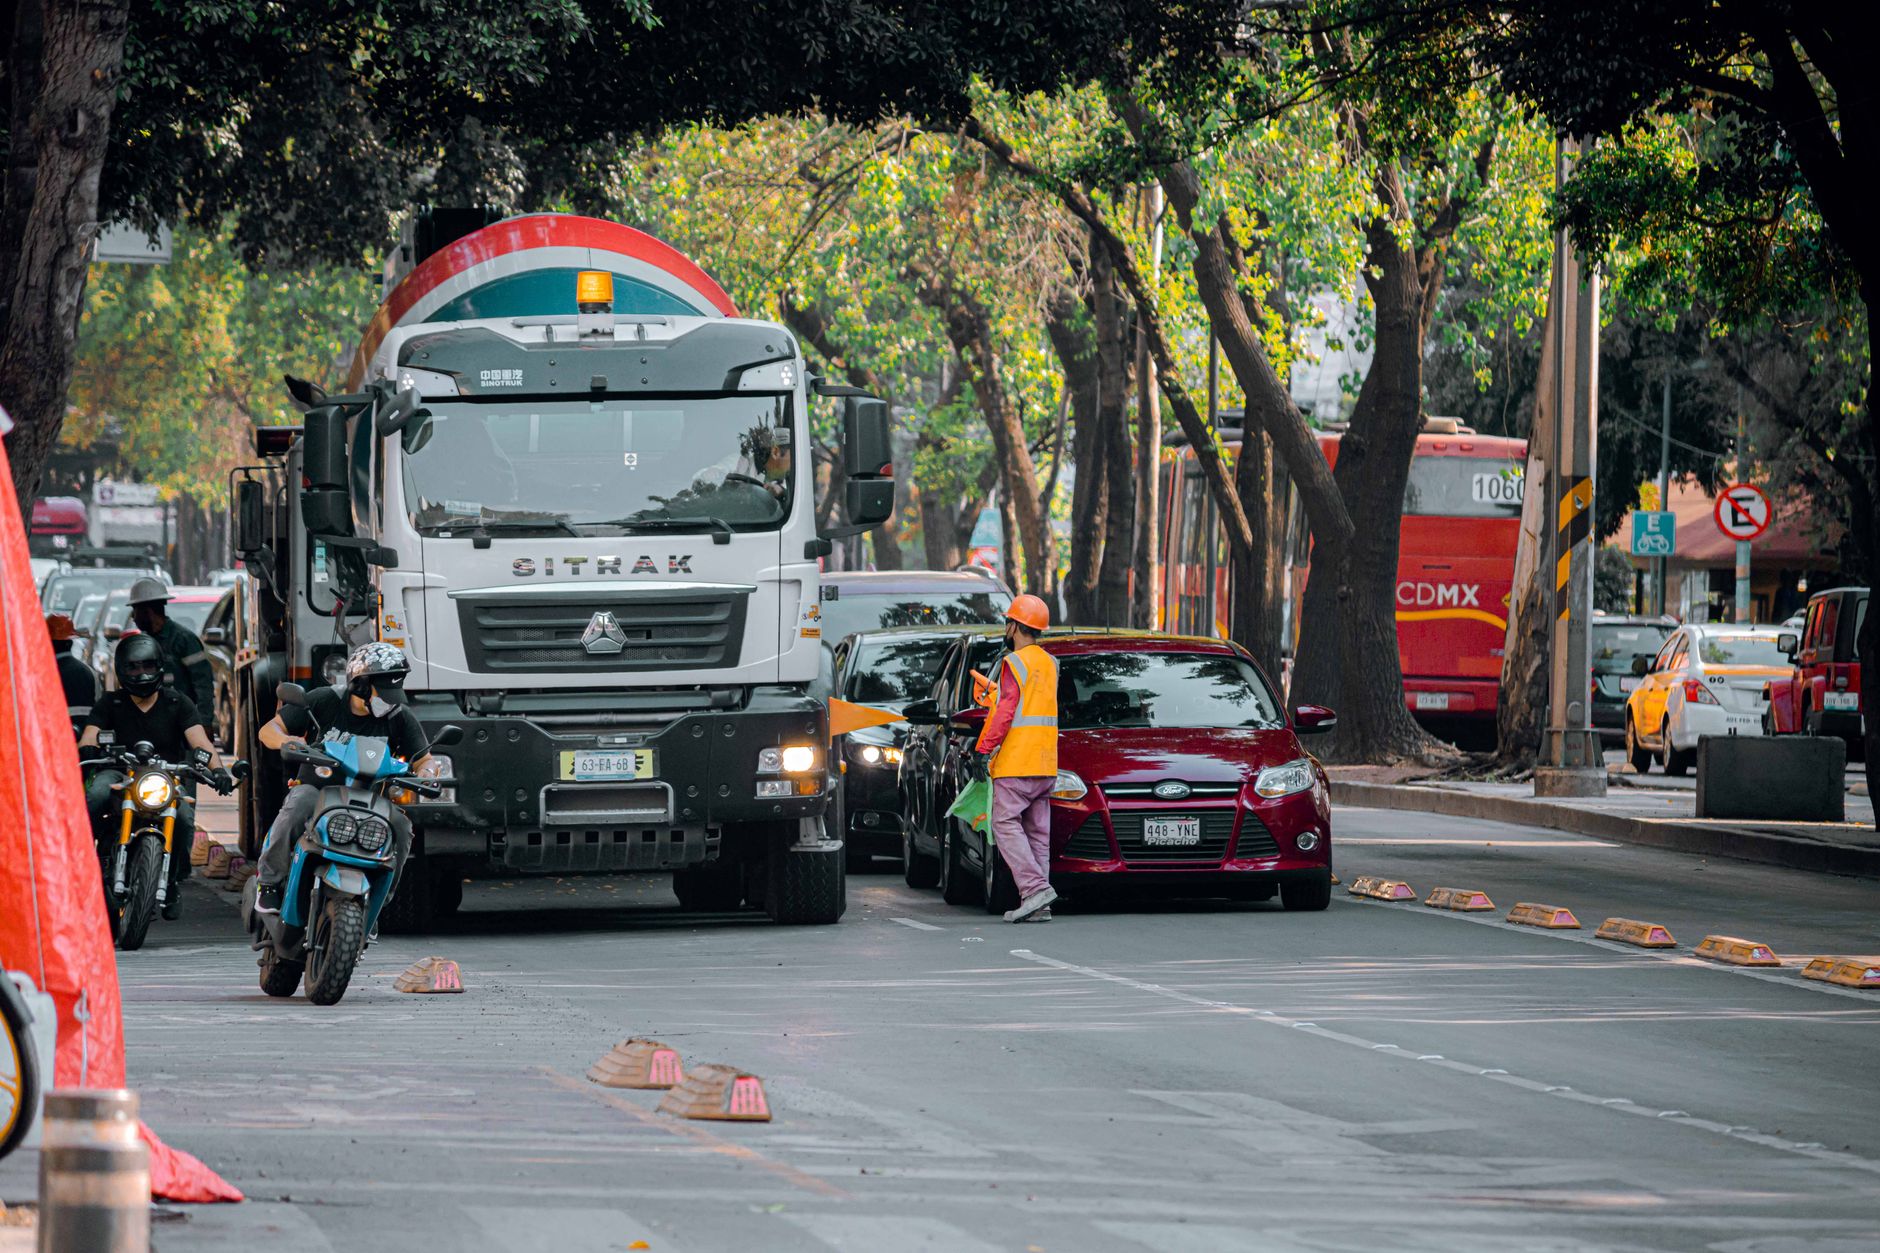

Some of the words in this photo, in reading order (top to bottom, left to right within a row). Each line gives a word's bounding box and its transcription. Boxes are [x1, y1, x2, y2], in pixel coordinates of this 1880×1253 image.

[1647, 514, 1660, 532] E
[512, 555, 693, 577] SITRAK
[1397, 581, 1480, 607] CDMX
[1147, 824, 1198, 837] 448-YNE
[1147, 836, 1197, 845] Picacho
